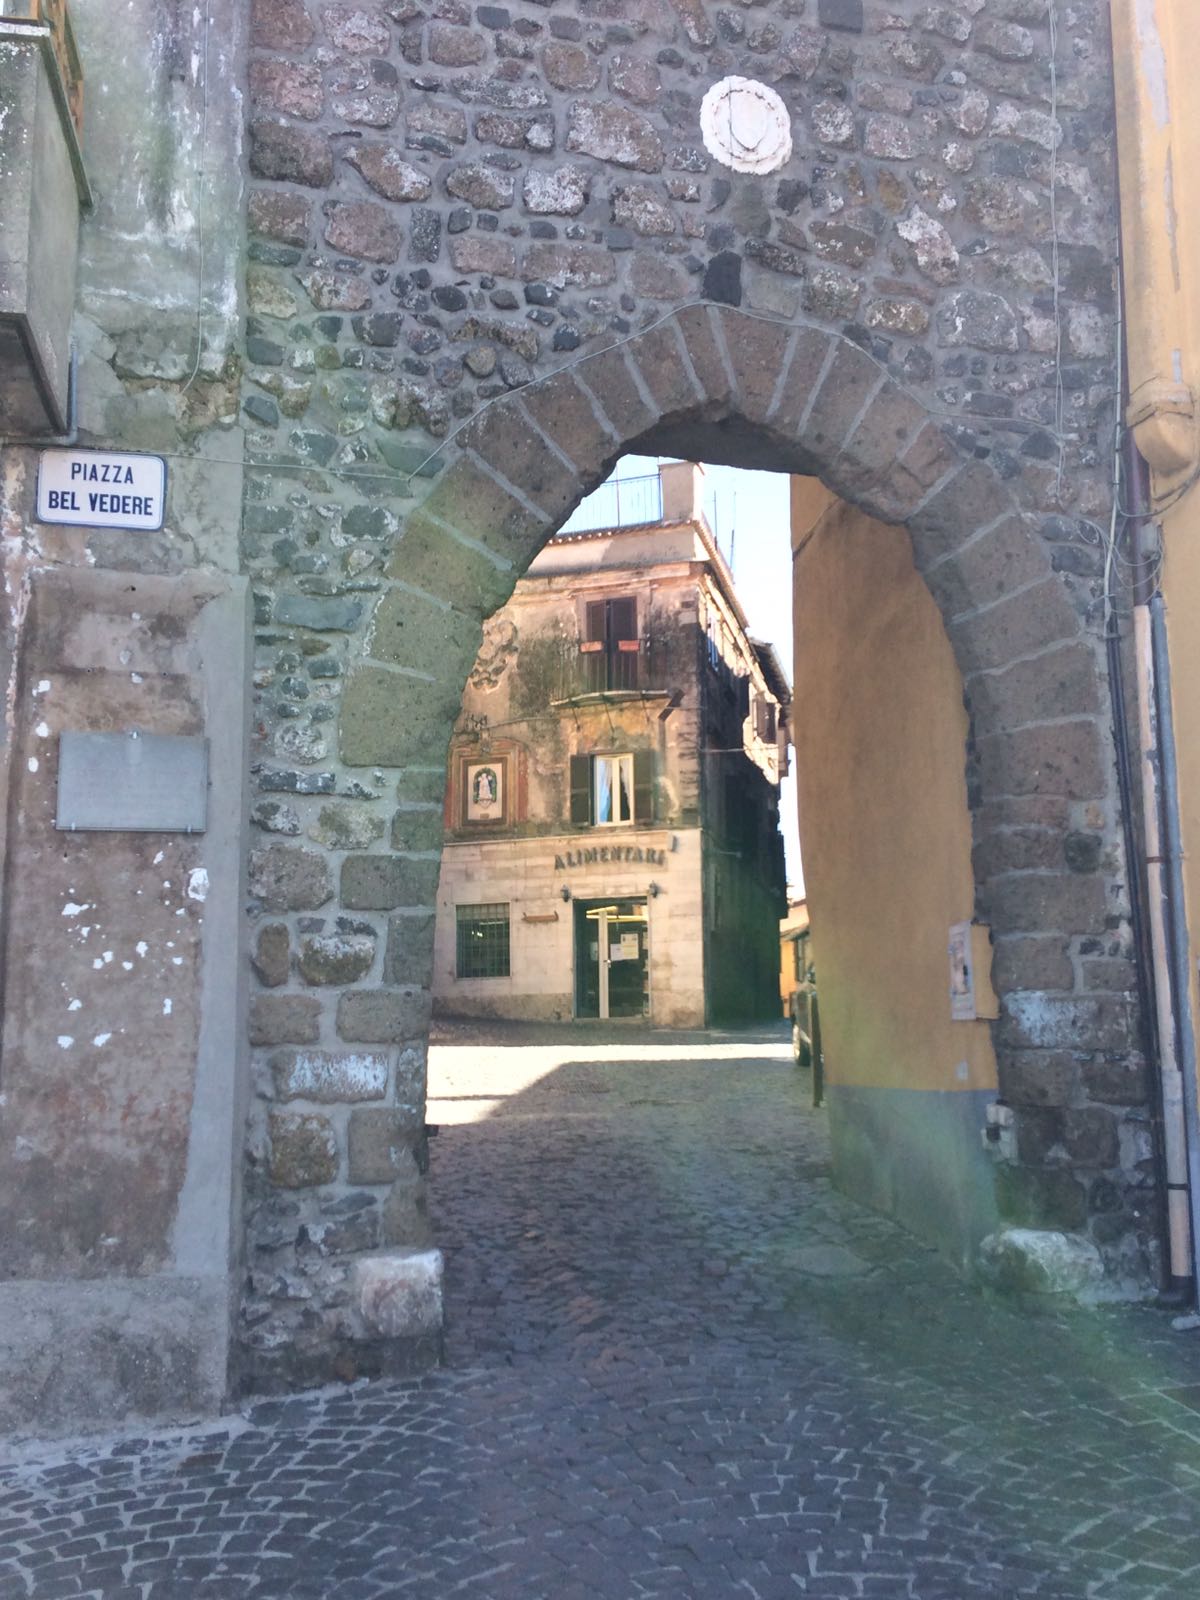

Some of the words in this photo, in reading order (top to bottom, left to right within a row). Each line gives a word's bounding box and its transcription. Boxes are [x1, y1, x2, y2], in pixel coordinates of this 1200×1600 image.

[71, 462, 134, 484] PIAZZA
[48, 490, 81, 511] BEL
[88, 493, 153, 516] VEDERE
[554, 846, 666, 870] ALIMENTARI
